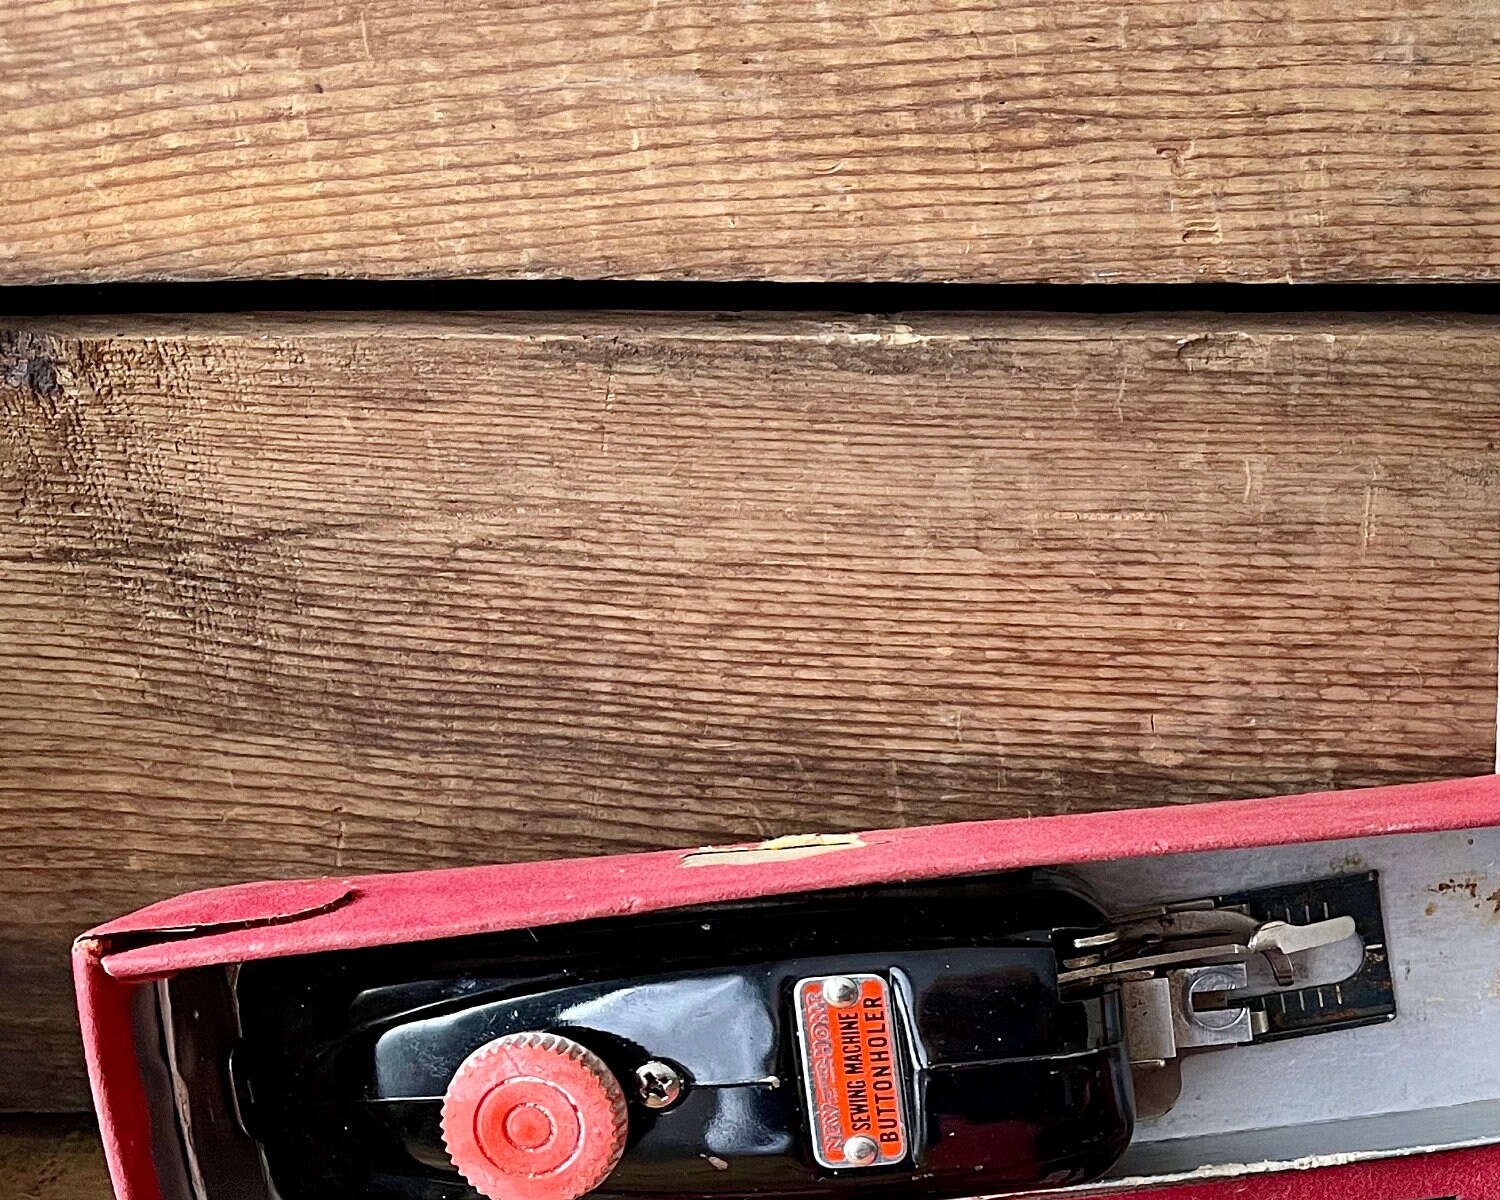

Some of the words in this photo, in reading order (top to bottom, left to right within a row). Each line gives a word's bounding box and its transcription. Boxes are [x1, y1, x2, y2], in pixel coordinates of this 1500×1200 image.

[838, 1012, 863, 1075] MACHINE
[863, 996, 900, 1143] BUTTONHOLER
[848, 1080, 872, 1132] SEWING
